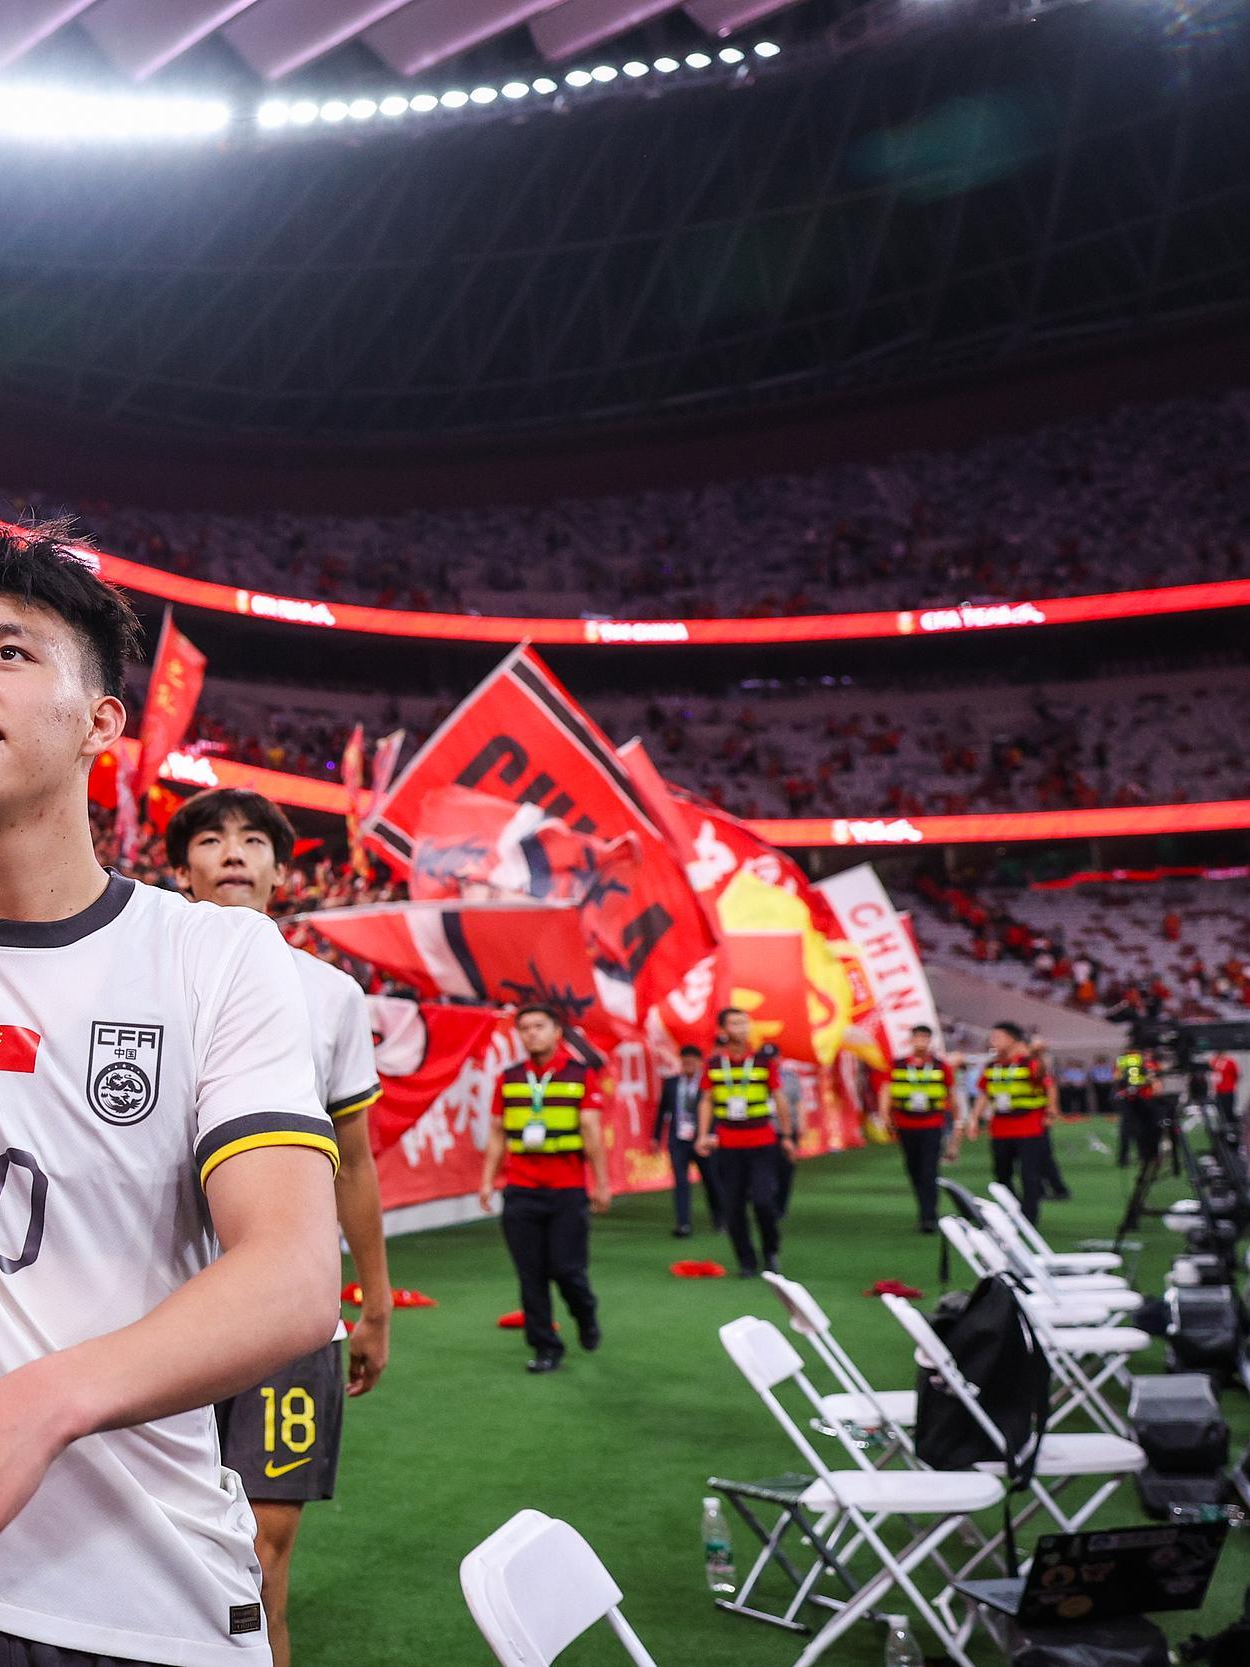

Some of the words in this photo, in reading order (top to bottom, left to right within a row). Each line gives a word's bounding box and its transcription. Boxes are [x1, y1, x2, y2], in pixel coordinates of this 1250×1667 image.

[97, 1028, 156, 1049] CFA
[114, 1047, 137, 1060] 中国
[260, 1386, 316, 1454] 18
